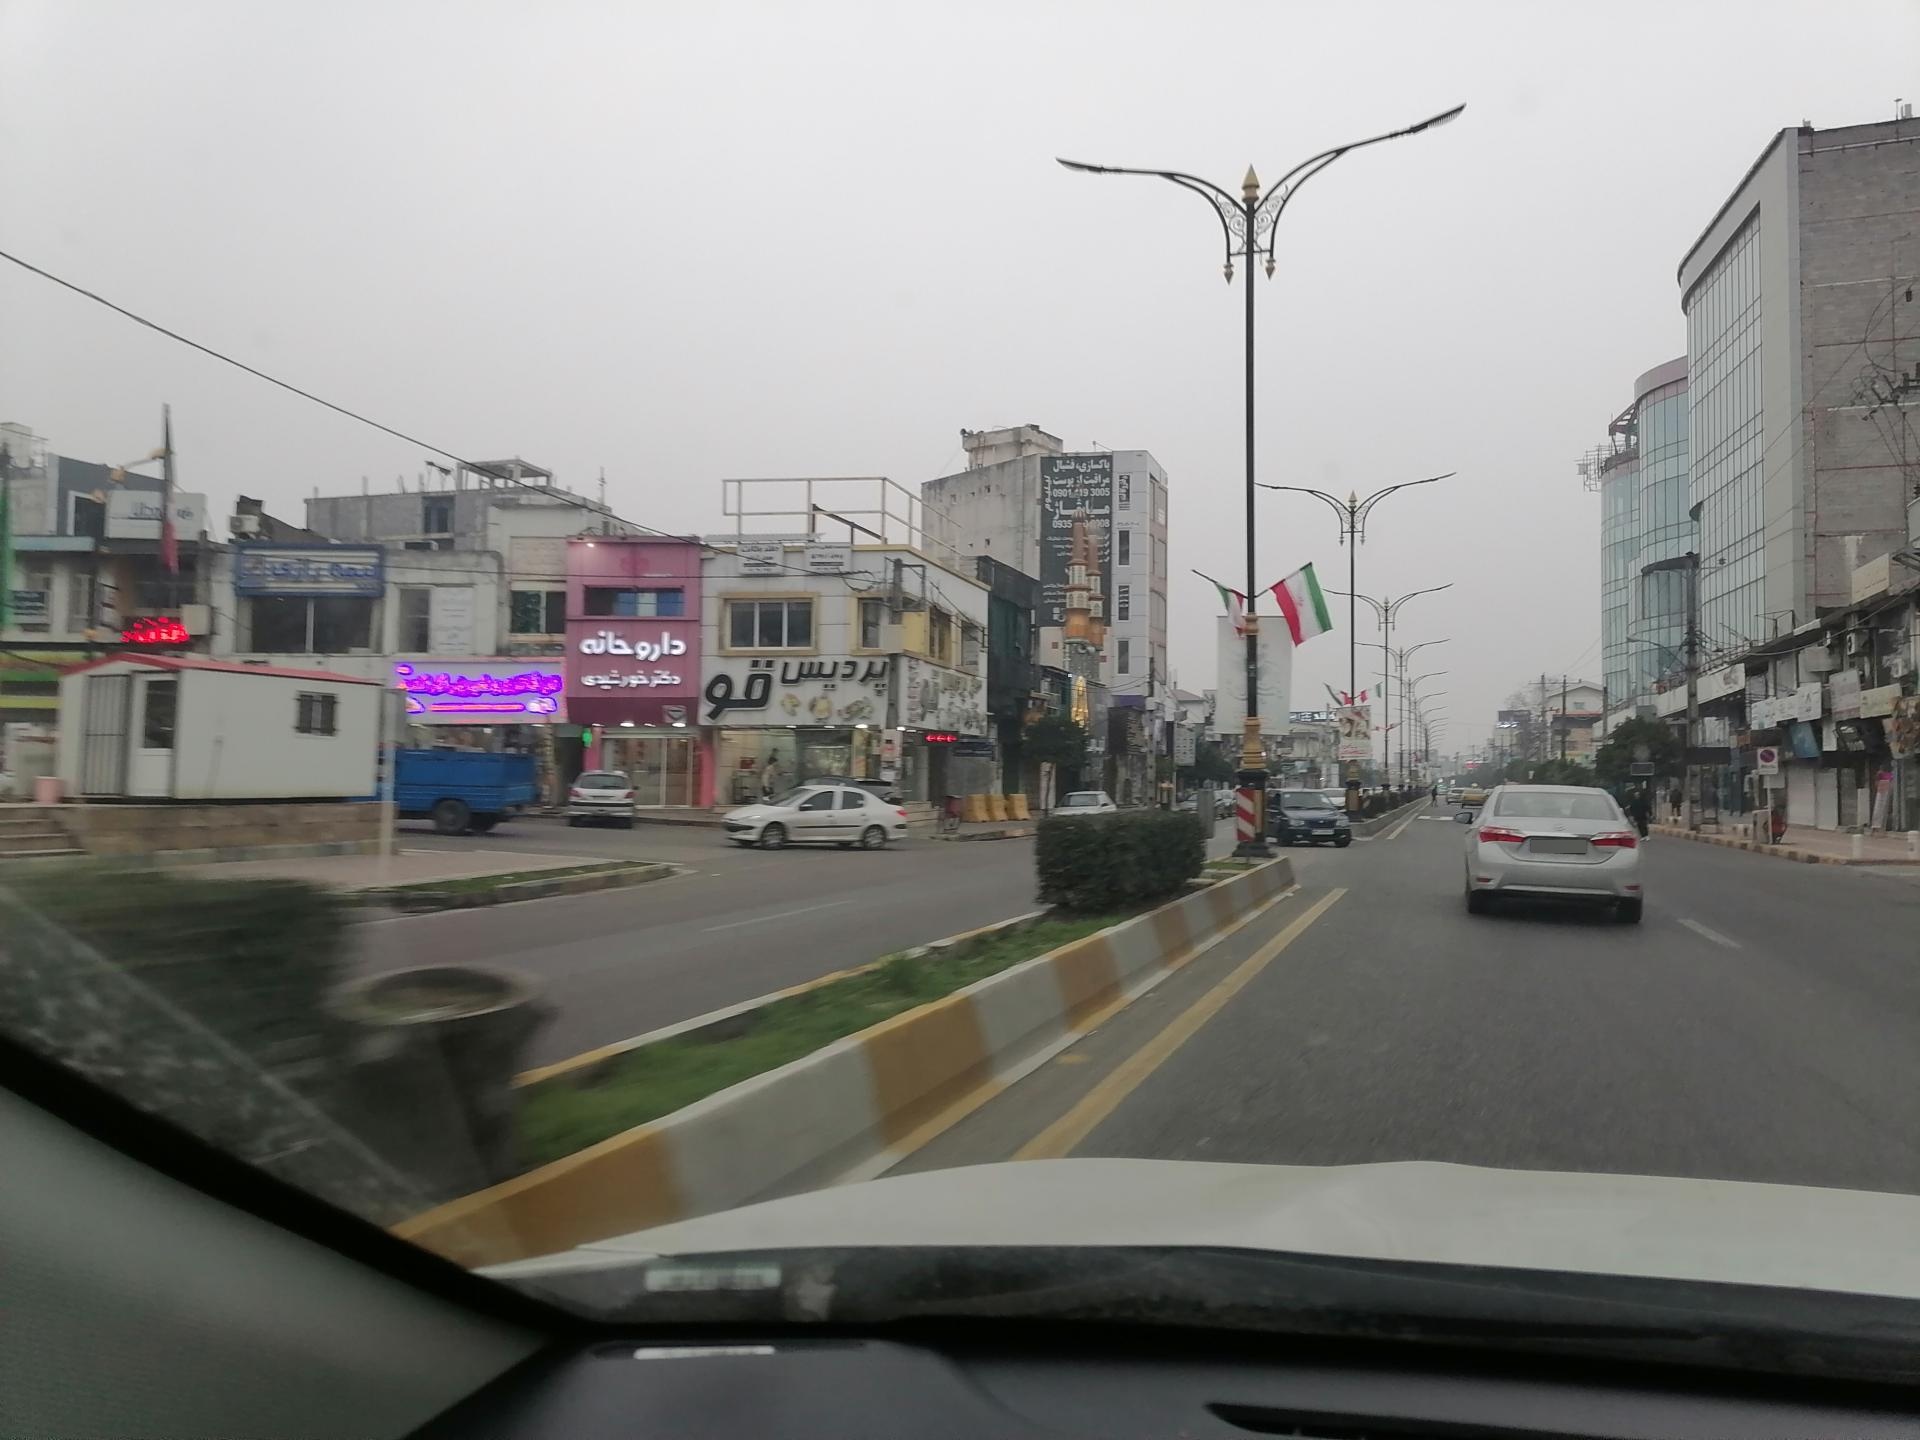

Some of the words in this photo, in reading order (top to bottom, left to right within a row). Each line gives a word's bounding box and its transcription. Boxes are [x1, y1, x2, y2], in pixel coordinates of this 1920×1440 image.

[1053, 476, 1074, 488] پوست
[1084, 473, 1110, 488] مراقبت
[1090, 488, 1110, 497] 3005
[1052, 519, 1073, 529] 0935
[579, 630, 687, 661] داروخانه
[581, 669, 650, 690] خورشیدی
[649, 669, 681, 687] دکتر
[781, 660, 888, 696] پردیس
[705, 658, 776, 720] قو
